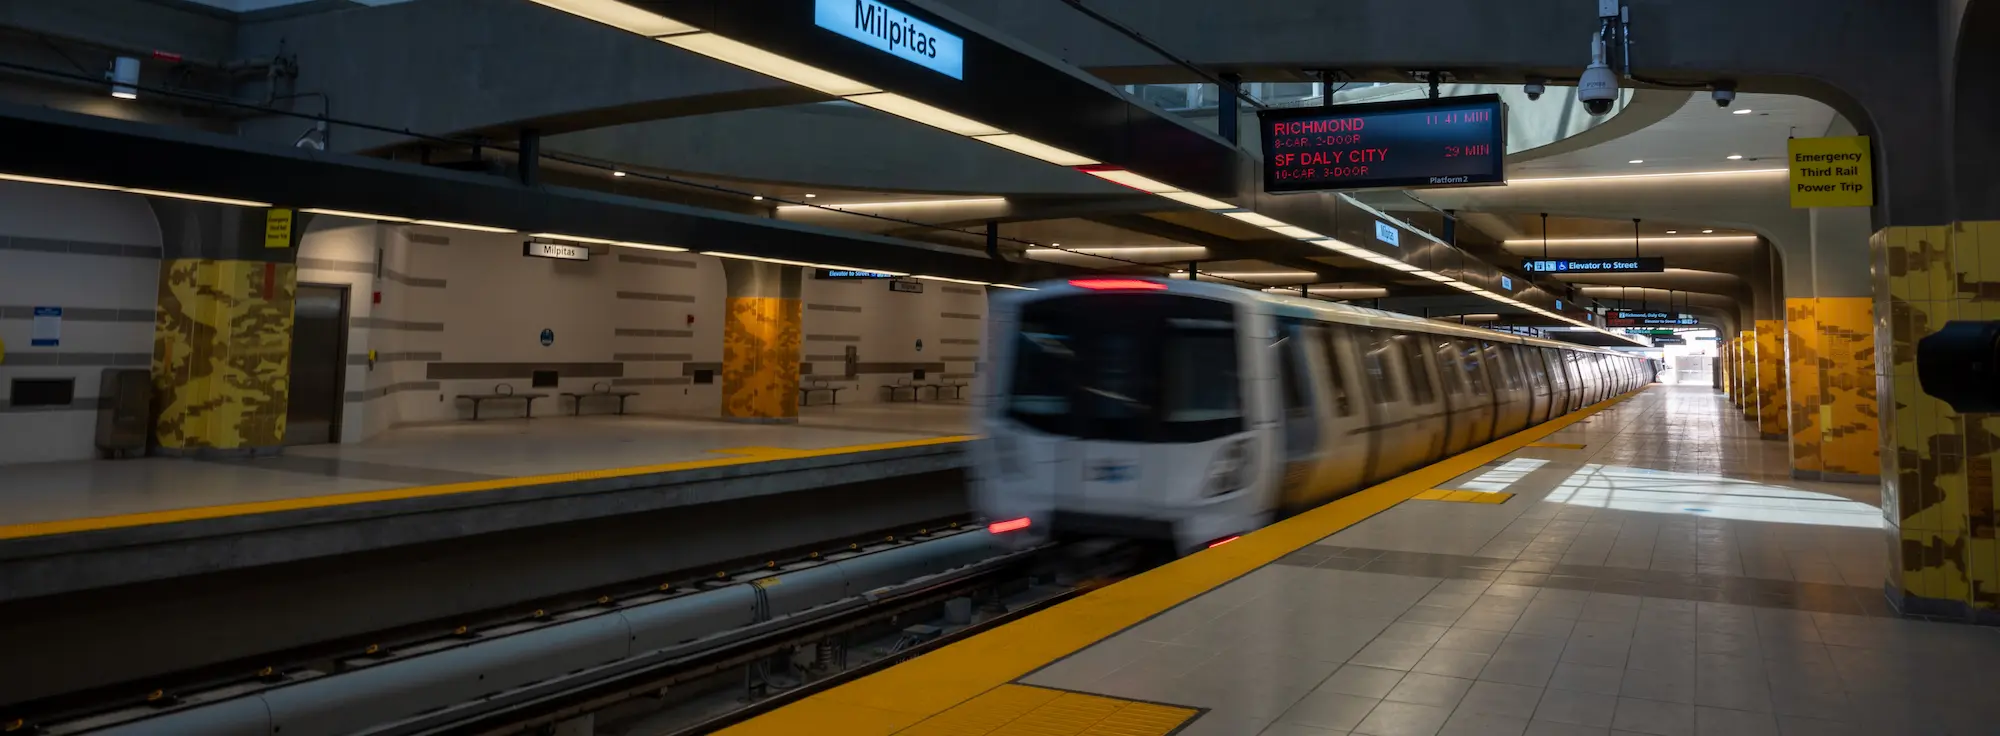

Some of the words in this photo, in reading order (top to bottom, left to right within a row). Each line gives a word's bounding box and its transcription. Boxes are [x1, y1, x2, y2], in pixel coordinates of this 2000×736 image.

[855, 0, 937, 58] Milpitas
[1464, 111, 1489, 122] MIN
[1274, 118, 1364, 135] RICHMOND
[1316, 133, 1361, 147] 2-DOOR
[1444, 145, 1460, 157] 29
[1465, 143, 1489, 156] MIN
[1275, 153, 1295, 167] SF
[1300, 150, 1344, 165] DALY
[1349, 148, 1388, 163] CITY
[1795, 153, 1862, 163] Emergency
[1323, 165, 1369, 178] 3-DOOR
[1800, 167, 1832, 176] Third
[1835, 166, 1858, 176] Rail
[1463, 175, 1469, 183] 2
[1797, 183, 1836, 192] Power
[1840, 182, 1863, 193] Trip
[543, 244, 575, 258] Milpitas
